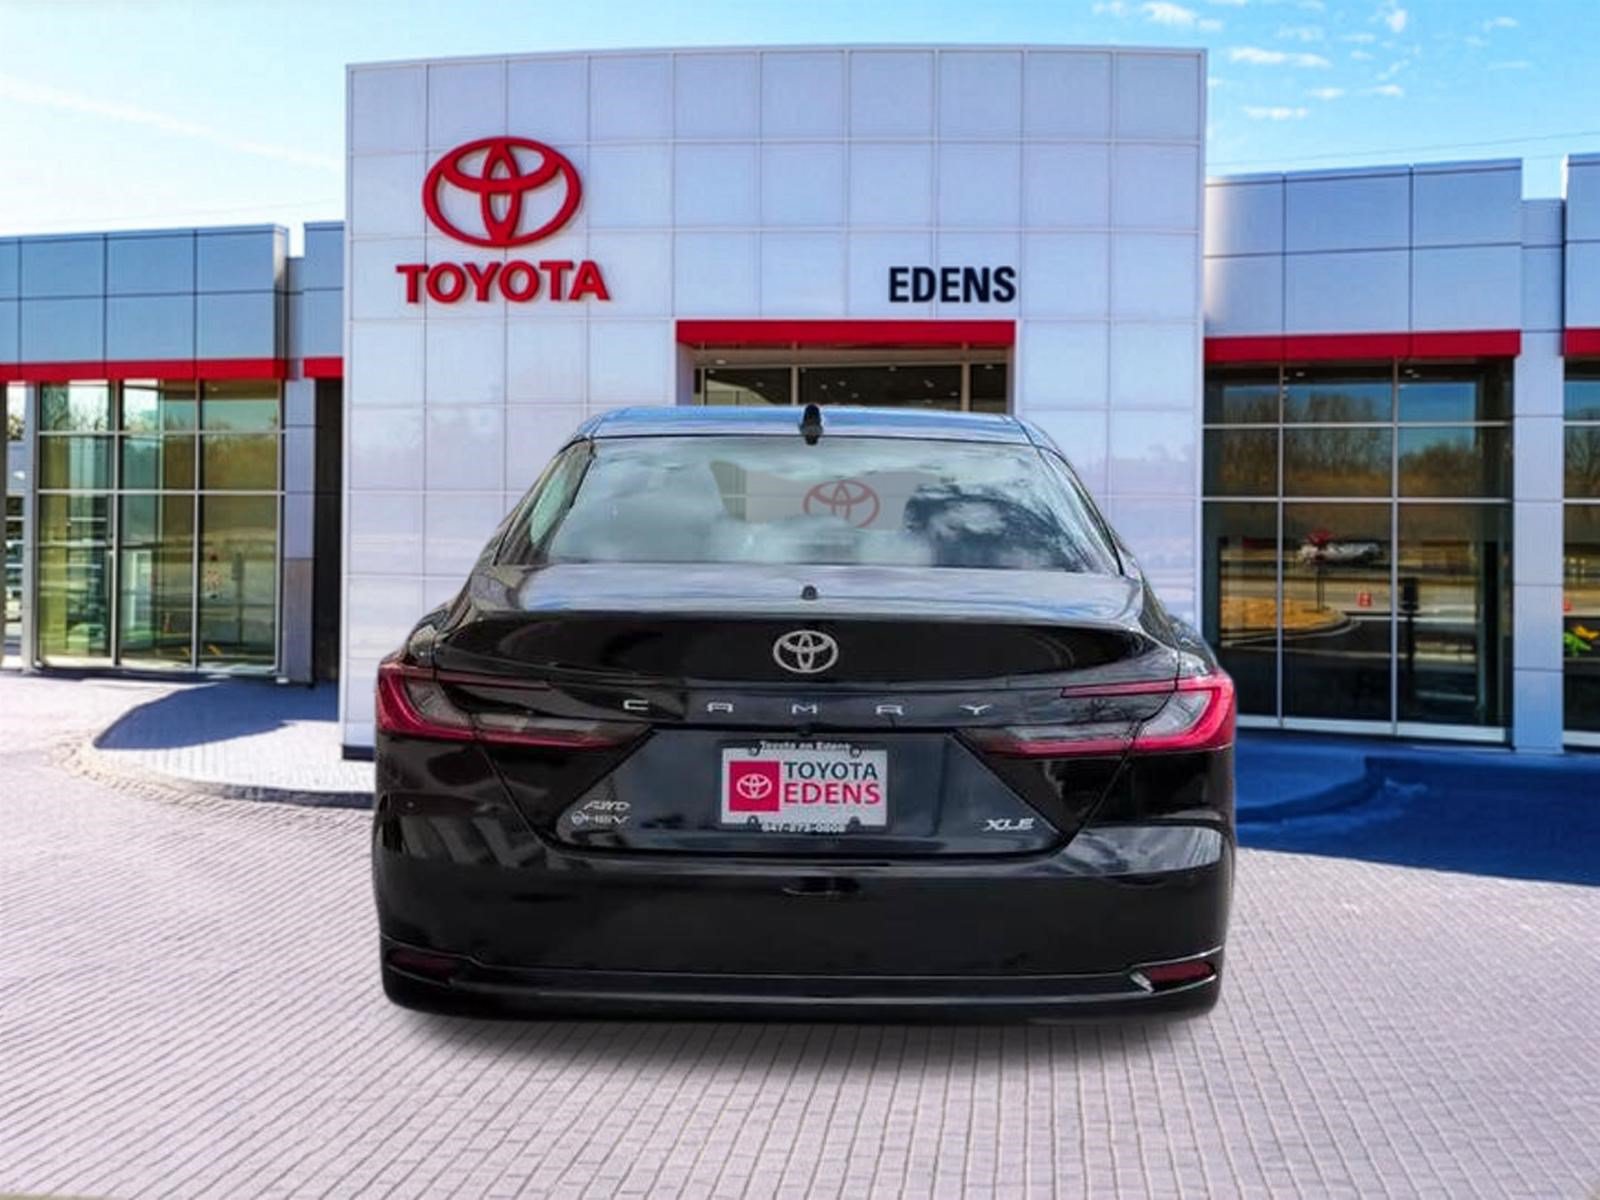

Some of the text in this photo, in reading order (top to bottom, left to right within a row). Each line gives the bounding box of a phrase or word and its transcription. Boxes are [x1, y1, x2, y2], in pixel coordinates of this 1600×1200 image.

[396, 260, 610, 303] TOYOTA
[889, 266, 1017, 303] EDENS
[623, 699, 991, 716] CAMRY
[783, 762, 878, 779] TOYOTA
[784, 783, 881, 804] EDENS
[583, 800, 631, 811] AWD
[982, 817, 1034, 831] XLE
